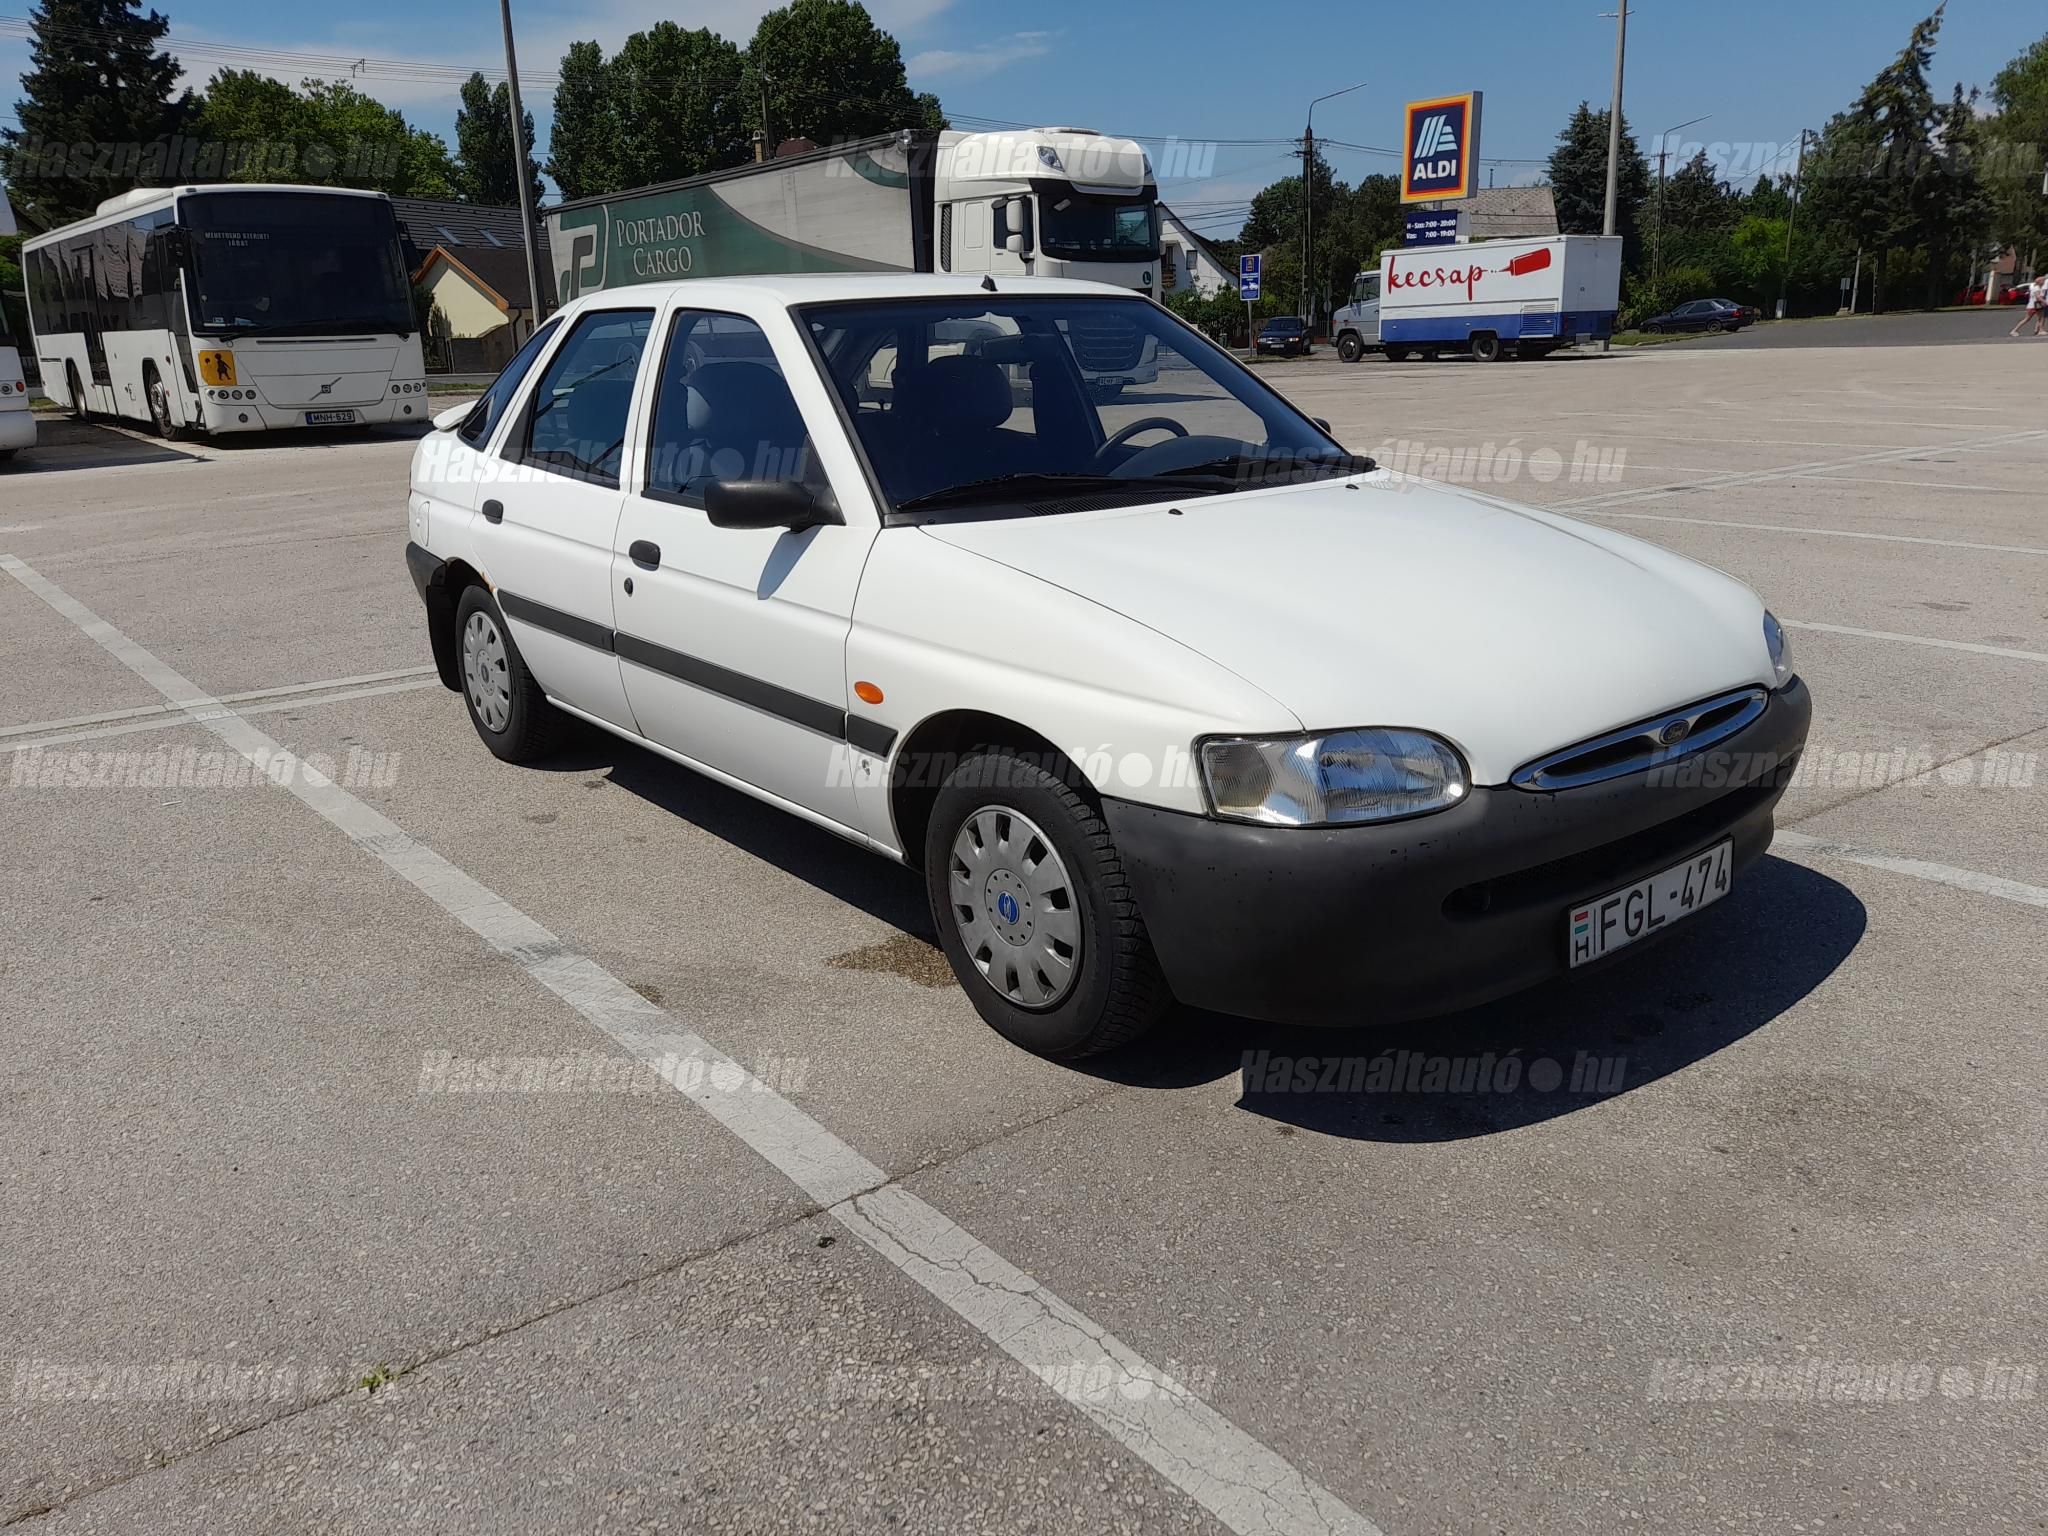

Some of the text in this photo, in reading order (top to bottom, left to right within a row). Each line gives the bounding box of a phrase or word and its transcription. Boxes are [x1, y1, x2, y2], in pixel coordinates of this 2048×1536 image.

[1413, 160, 1457, 180] ALDI
[616, 211, 706, 247] PORTADOR
[633, 246, 692, 276] CARGO
[1388, 255, 1487, 301] kecsap
[313, 411, 352, 421] MNH-629
[1575, 848, 1727, 962] H FGL-474
